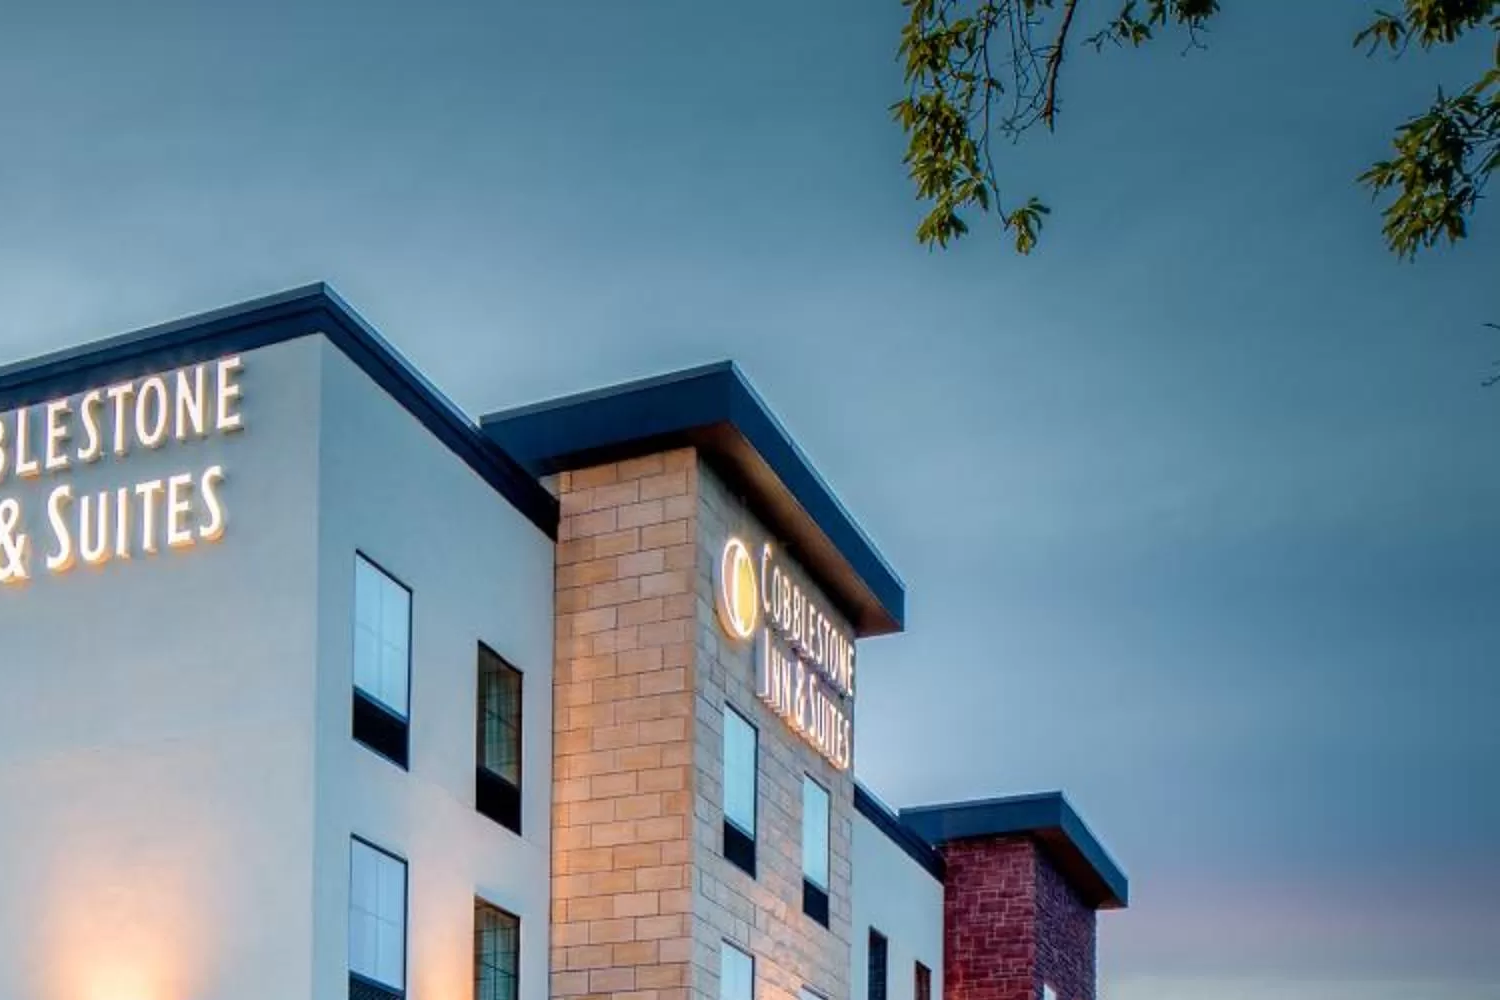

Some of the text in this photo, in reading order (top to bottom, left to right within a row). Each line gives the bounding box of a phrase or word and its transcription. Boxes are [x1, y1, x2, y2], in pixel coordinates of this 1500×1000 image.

[45, 464, 224, 572] SUITES
[760, 542, 855, 697] COBBLESTONE
[759, 627, 791, 717] INN
[808, 672, 851, 770] SUITES
